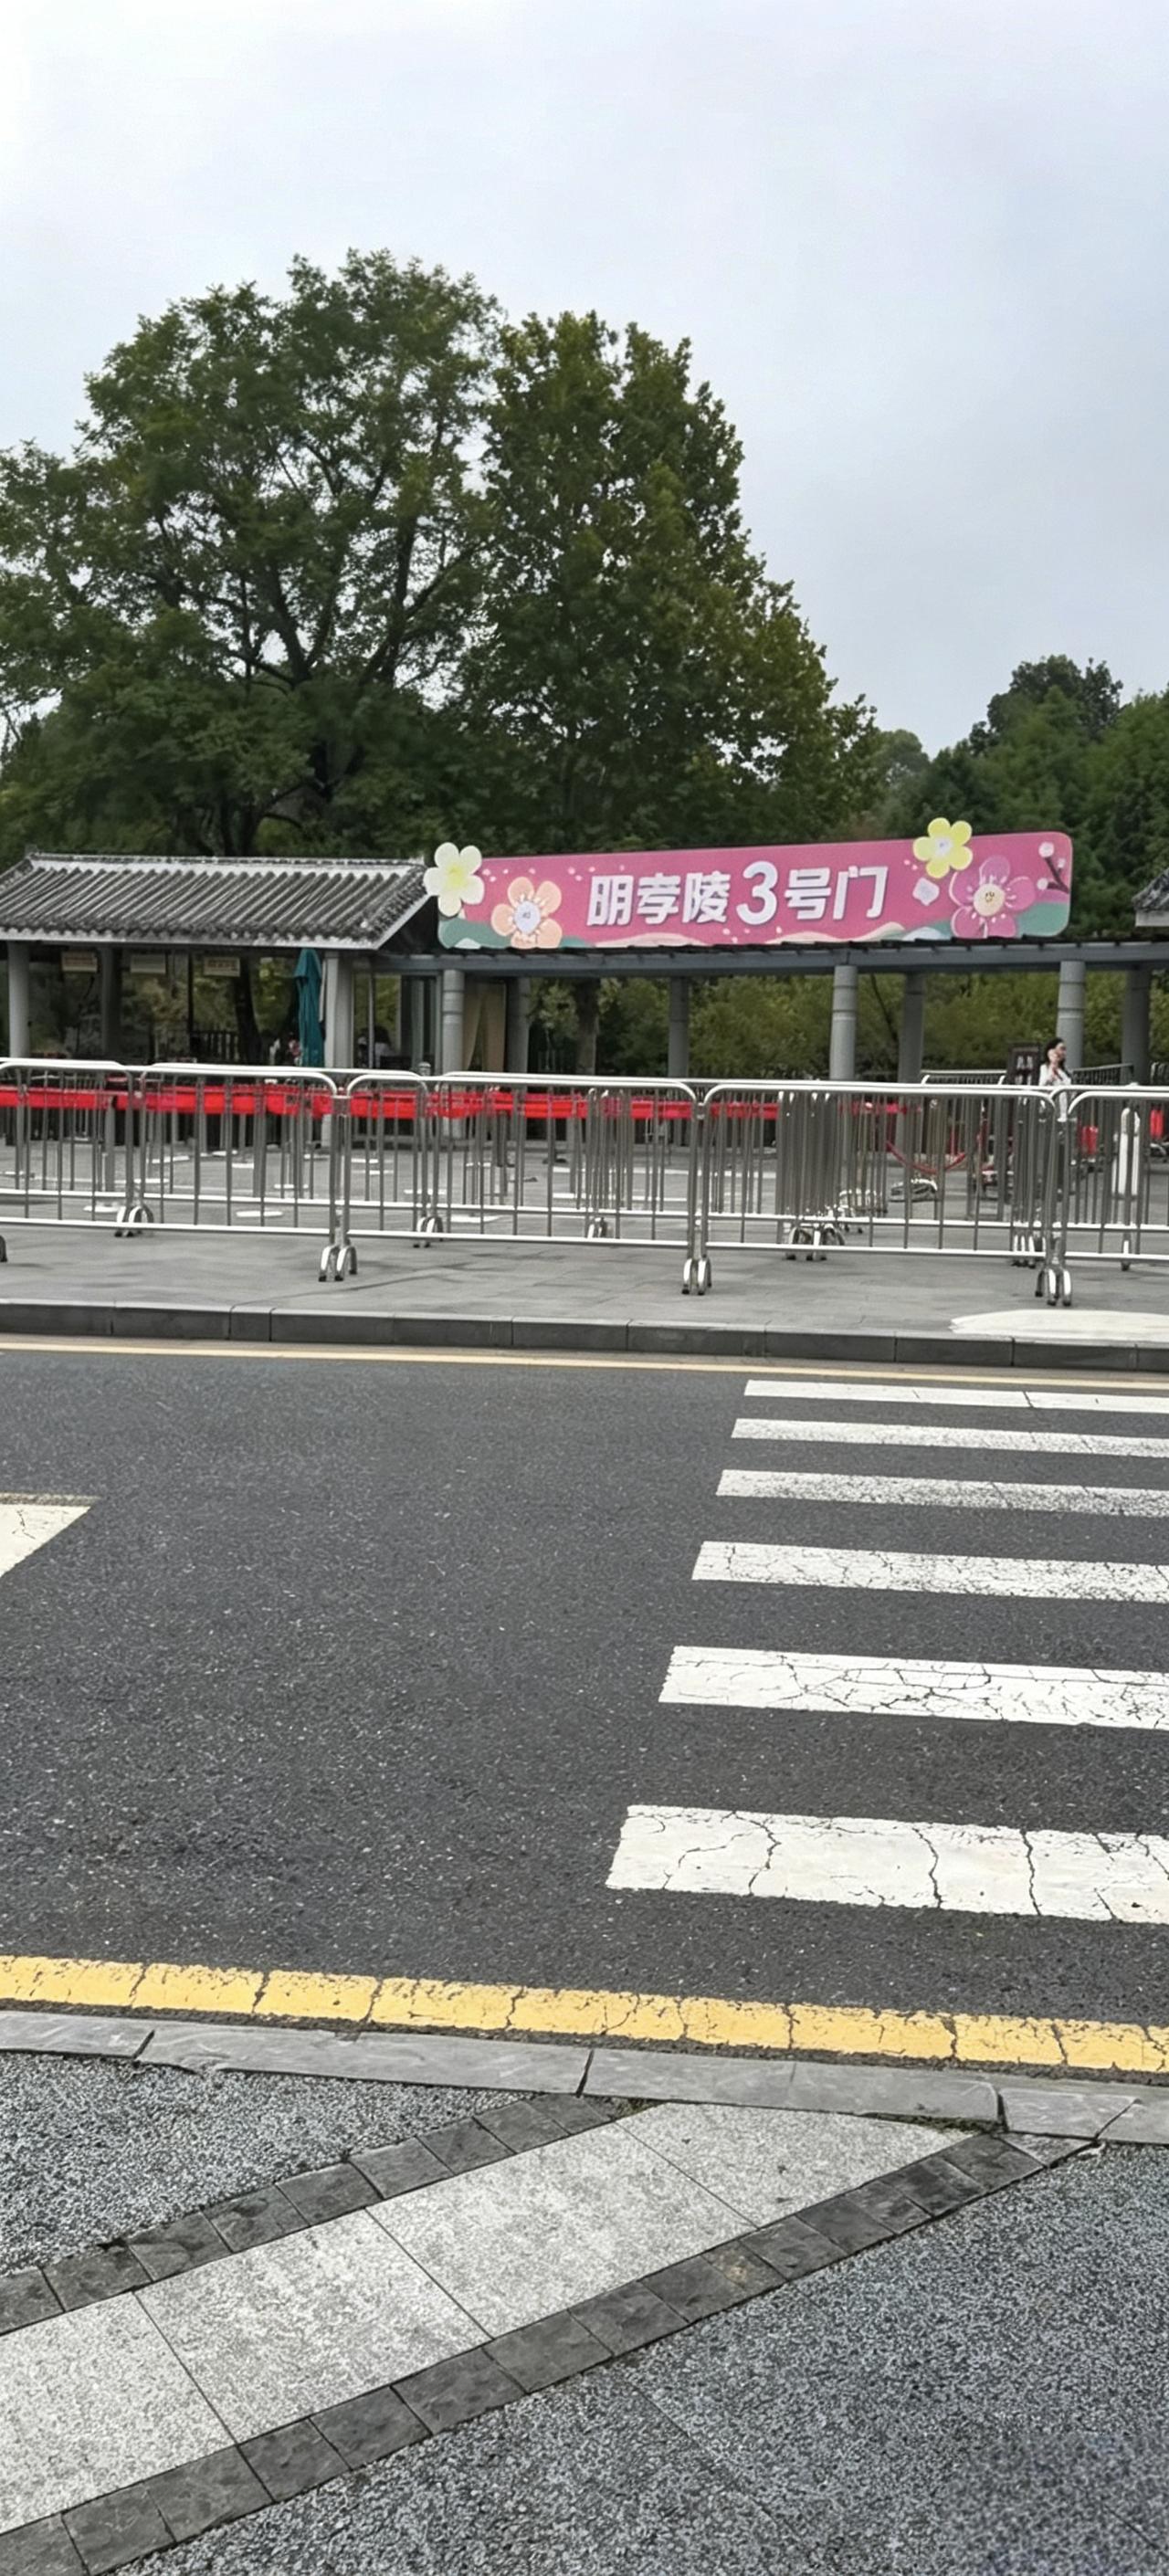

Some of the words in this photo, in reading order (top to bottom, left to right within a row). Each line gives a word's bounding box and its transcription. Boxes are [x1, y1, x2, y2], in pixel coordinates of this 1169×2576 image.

[586, 860, 889, 925] 明孝陵3号门
